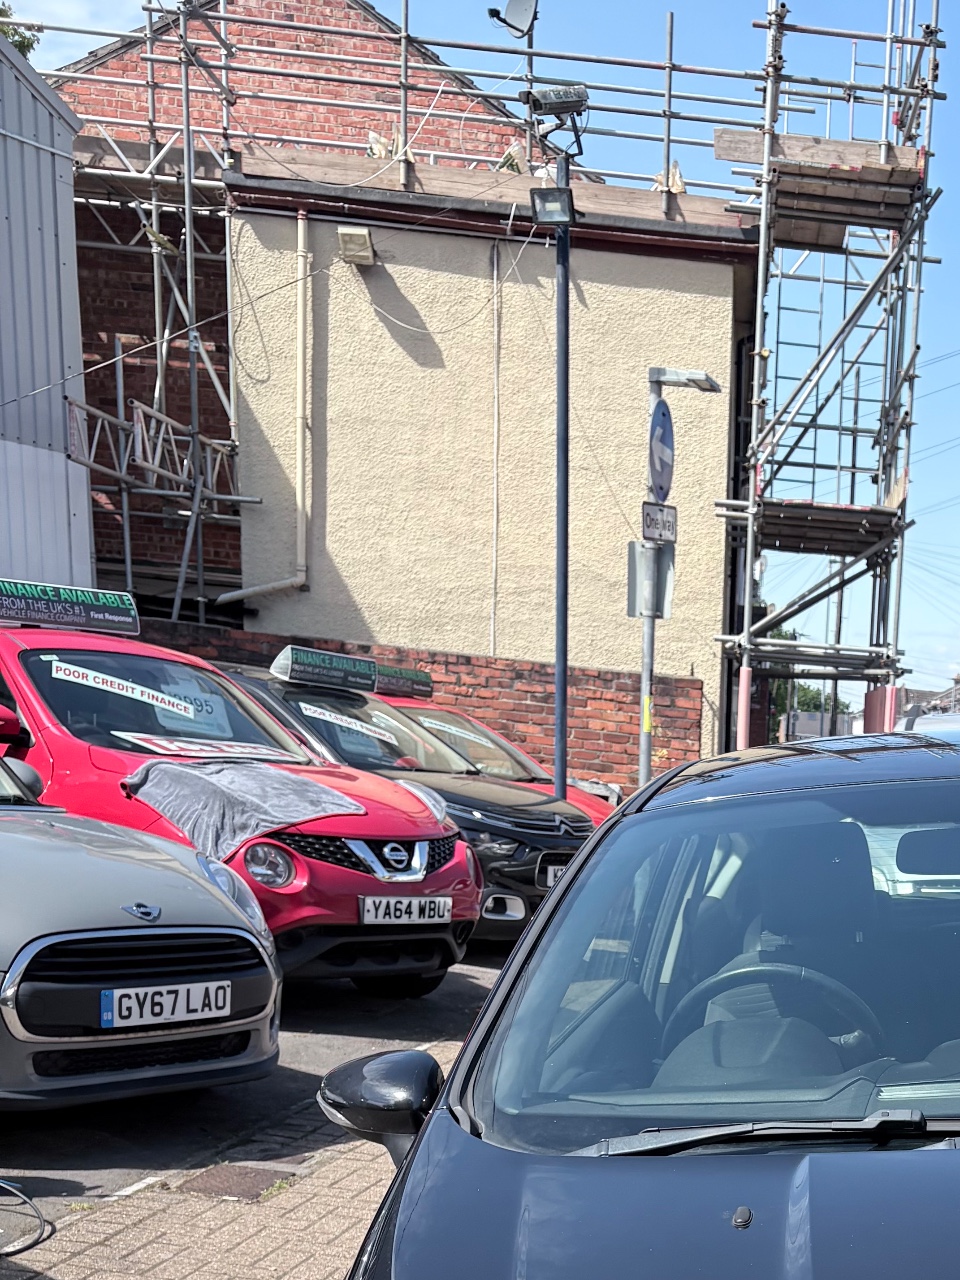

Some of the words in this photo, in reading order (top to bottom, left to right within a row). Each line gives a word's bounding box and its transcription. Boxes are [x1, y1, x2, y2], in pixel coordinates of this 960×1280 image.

[645, 512, 660, 530] One
[0, 580, 58, 601] INANCE
[60, 588, 134, 609] AVAILABLE
[27, 599, 49, 612] THE
[49, 601, 73, 615] UK'S
[74, 605, 86, 616] #1
[27, 610, 55, 621] FINANCE
[292, 650, 331, 668] FINANCE
[55, 665, 89, 682] POOR
[93, 675, 136, 695] CREDIT
[140, 690, 191, 715] FINANCE
[373, 899, 413, 920] YA64
[418, 900, 446, 919] WBU
[117, 988, 179, 1020] GY67
[186, 985, 227, 1014] LAO
